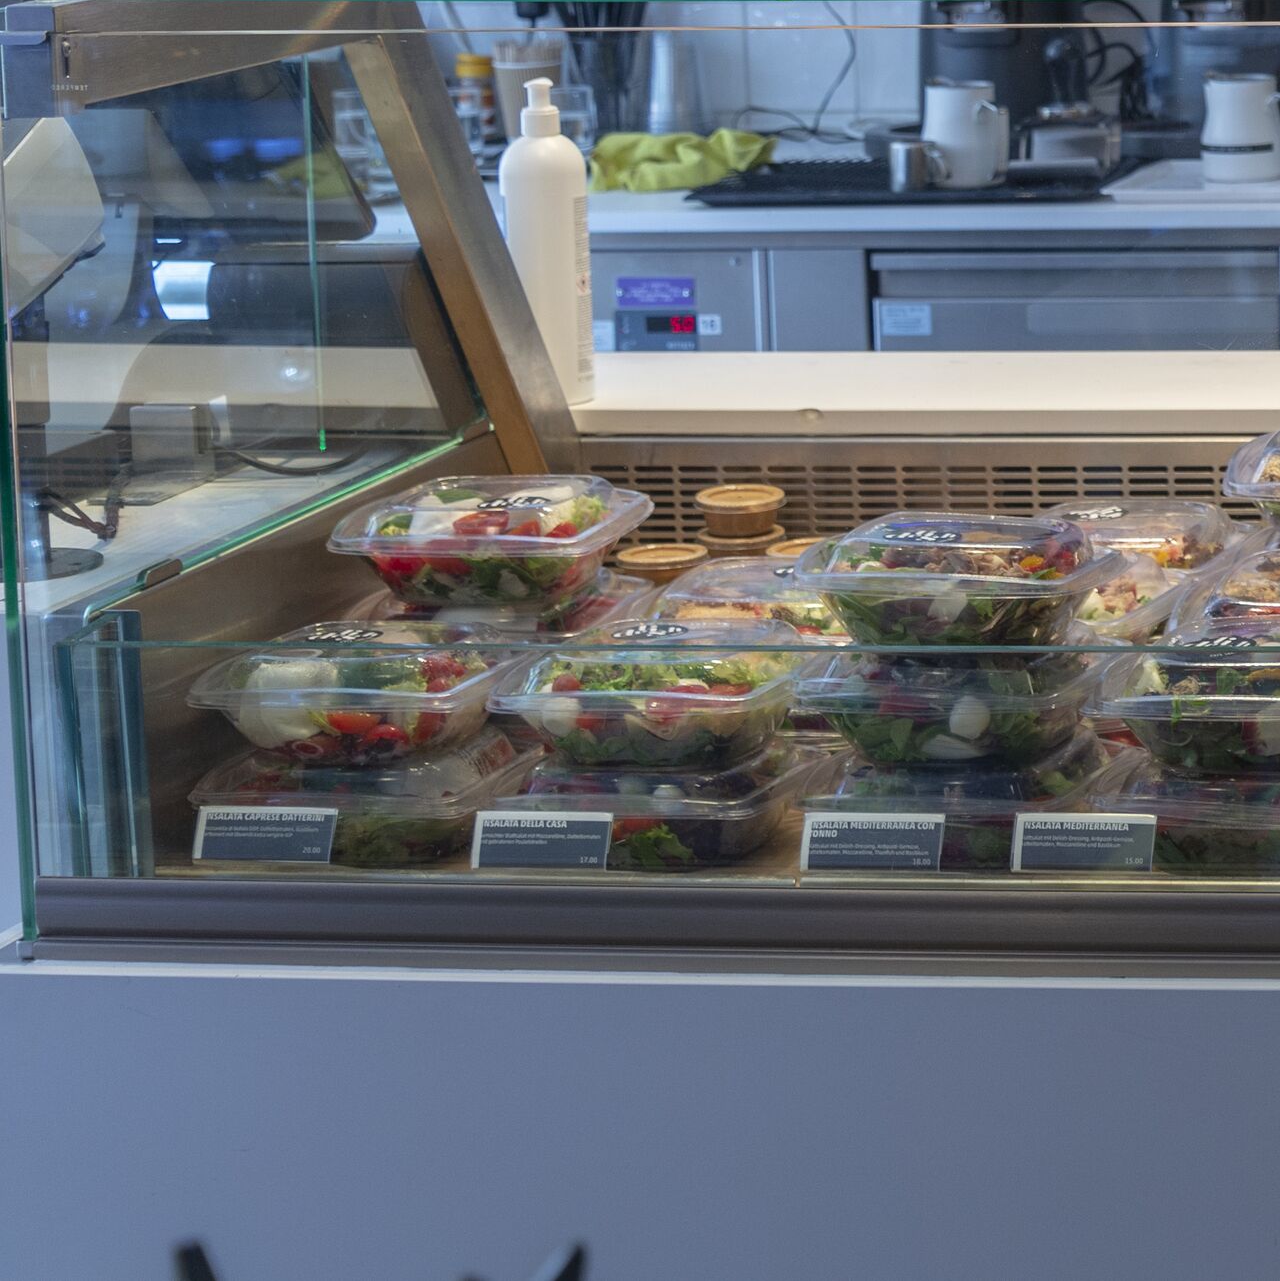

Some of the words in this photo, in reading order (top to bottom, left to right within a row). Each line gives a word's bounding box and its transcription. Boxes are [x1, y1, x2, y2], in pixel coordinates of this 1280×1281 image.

[282, 814, 325, 822] DATTERINI
[850, 822, 915, 830] MEDITERRANEA
[918, 822, 935, 830] CON
[1063, 822, 1129, 831] MEDITERRANEA
